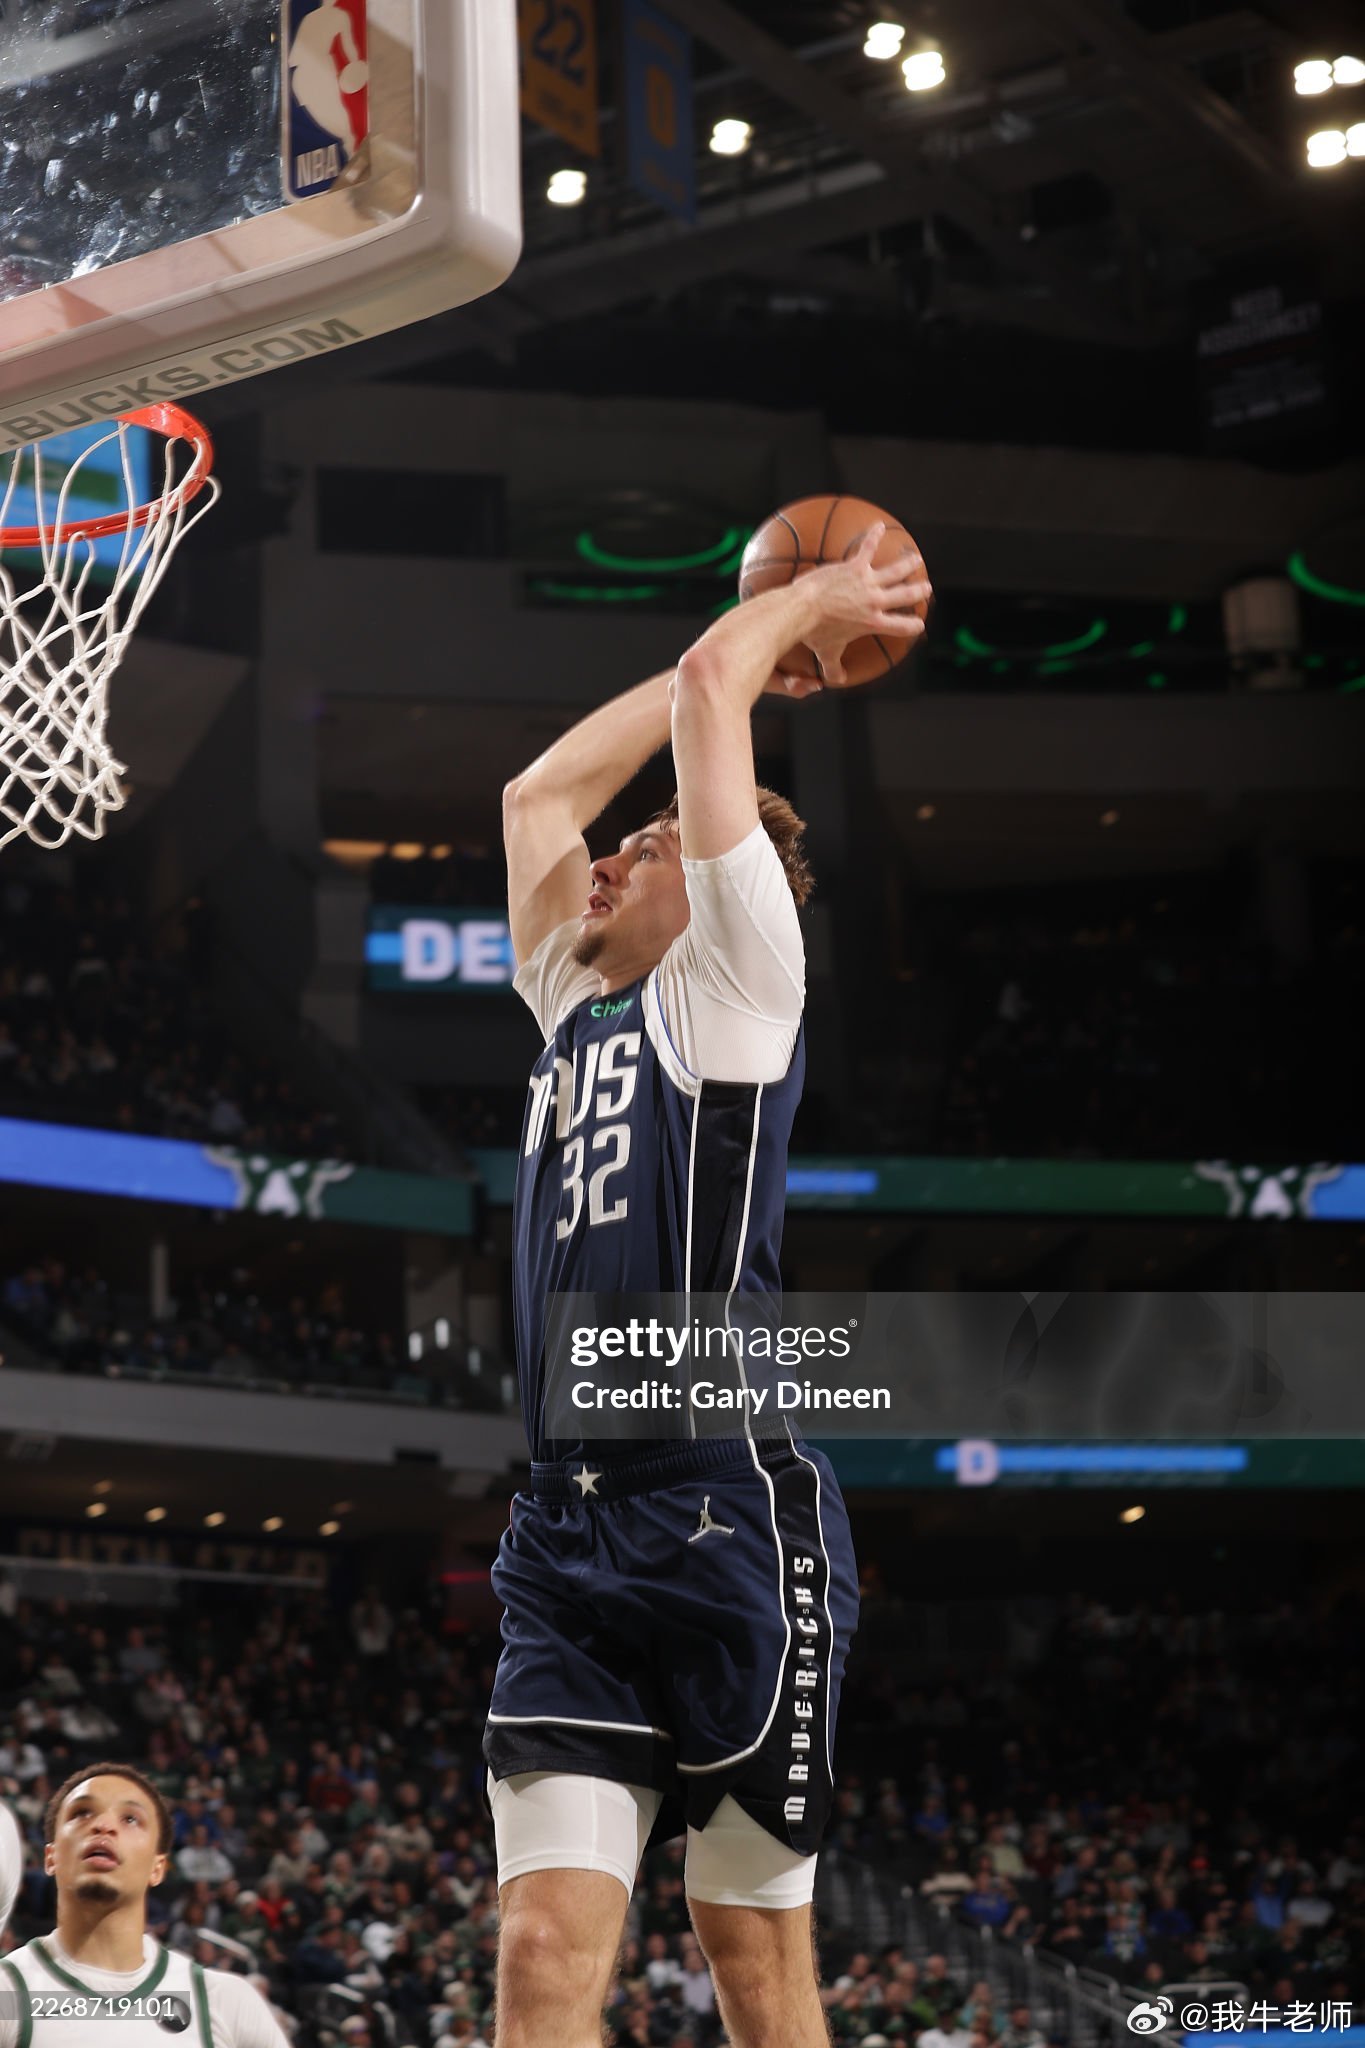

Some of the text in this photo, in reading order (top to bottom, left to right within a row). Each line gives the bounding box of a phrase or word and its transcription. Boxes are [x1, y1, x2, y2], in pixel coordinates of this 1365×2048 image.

[296, 143, 339, 190] NBA
[402, 919, 519, 982] DE
[556, 1122, 631, 1241] 32
